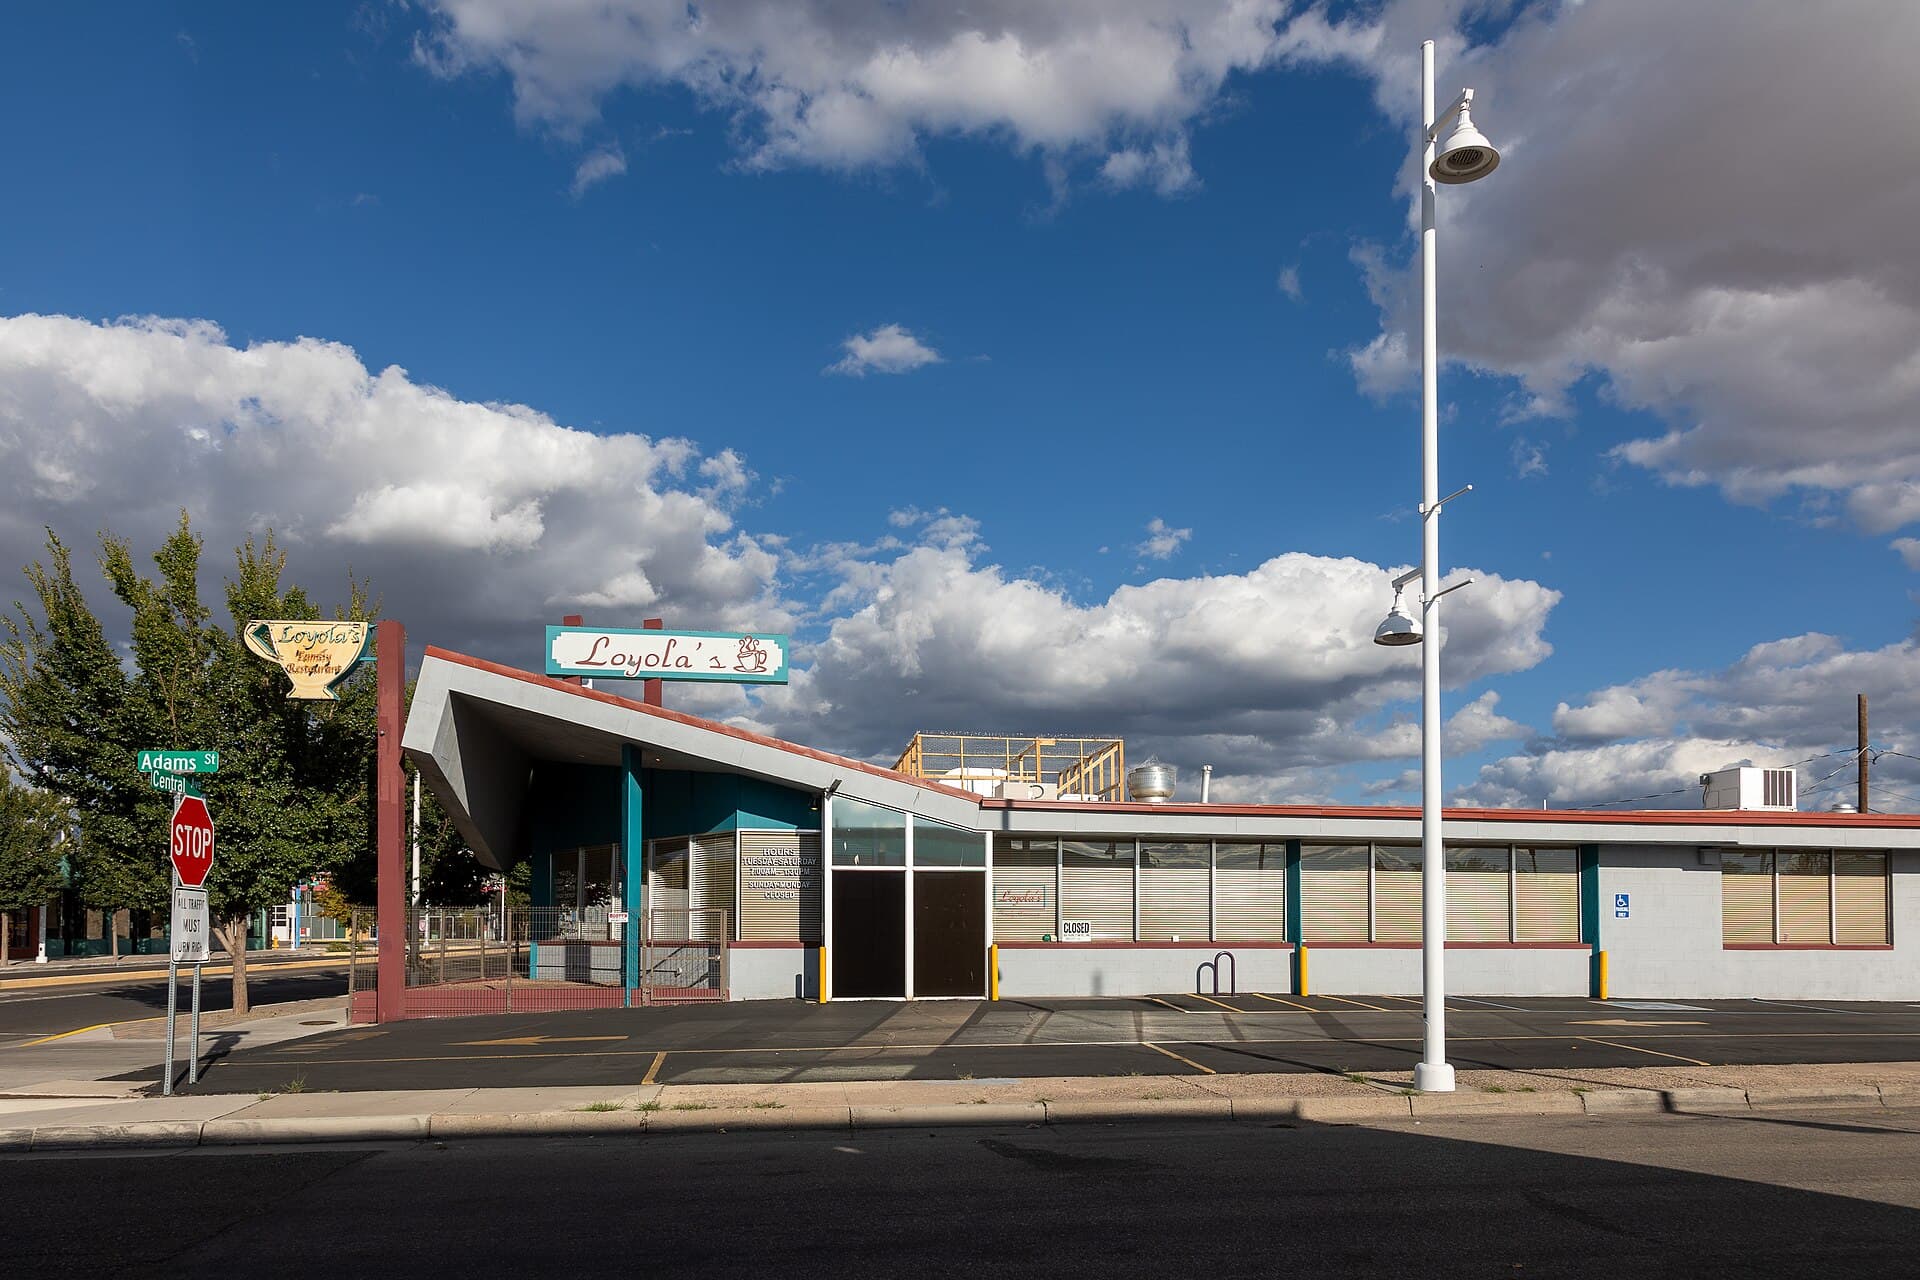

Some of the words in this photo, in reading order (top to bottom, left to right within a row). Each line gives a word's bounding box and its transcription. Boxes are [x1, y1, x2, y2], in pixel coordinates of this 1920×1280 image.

[277, 624, 360, 650] Loyola's
[575, 636, 726, 676] Loyola's
[141, 753, 197, 770] Adams
[204, 753, 216, 765] St
[152, 769, 186, 793] Central
[174, 823, 211, 859] STOP
[762, 848, 796, 856] HOURS
[764, 891, 796, 899] CLOSED
[998, 890, 1041, 906] Loyola's
[183, 919, 201, 933] MUST
[1063, 922, 1090, 934] CLOSED
